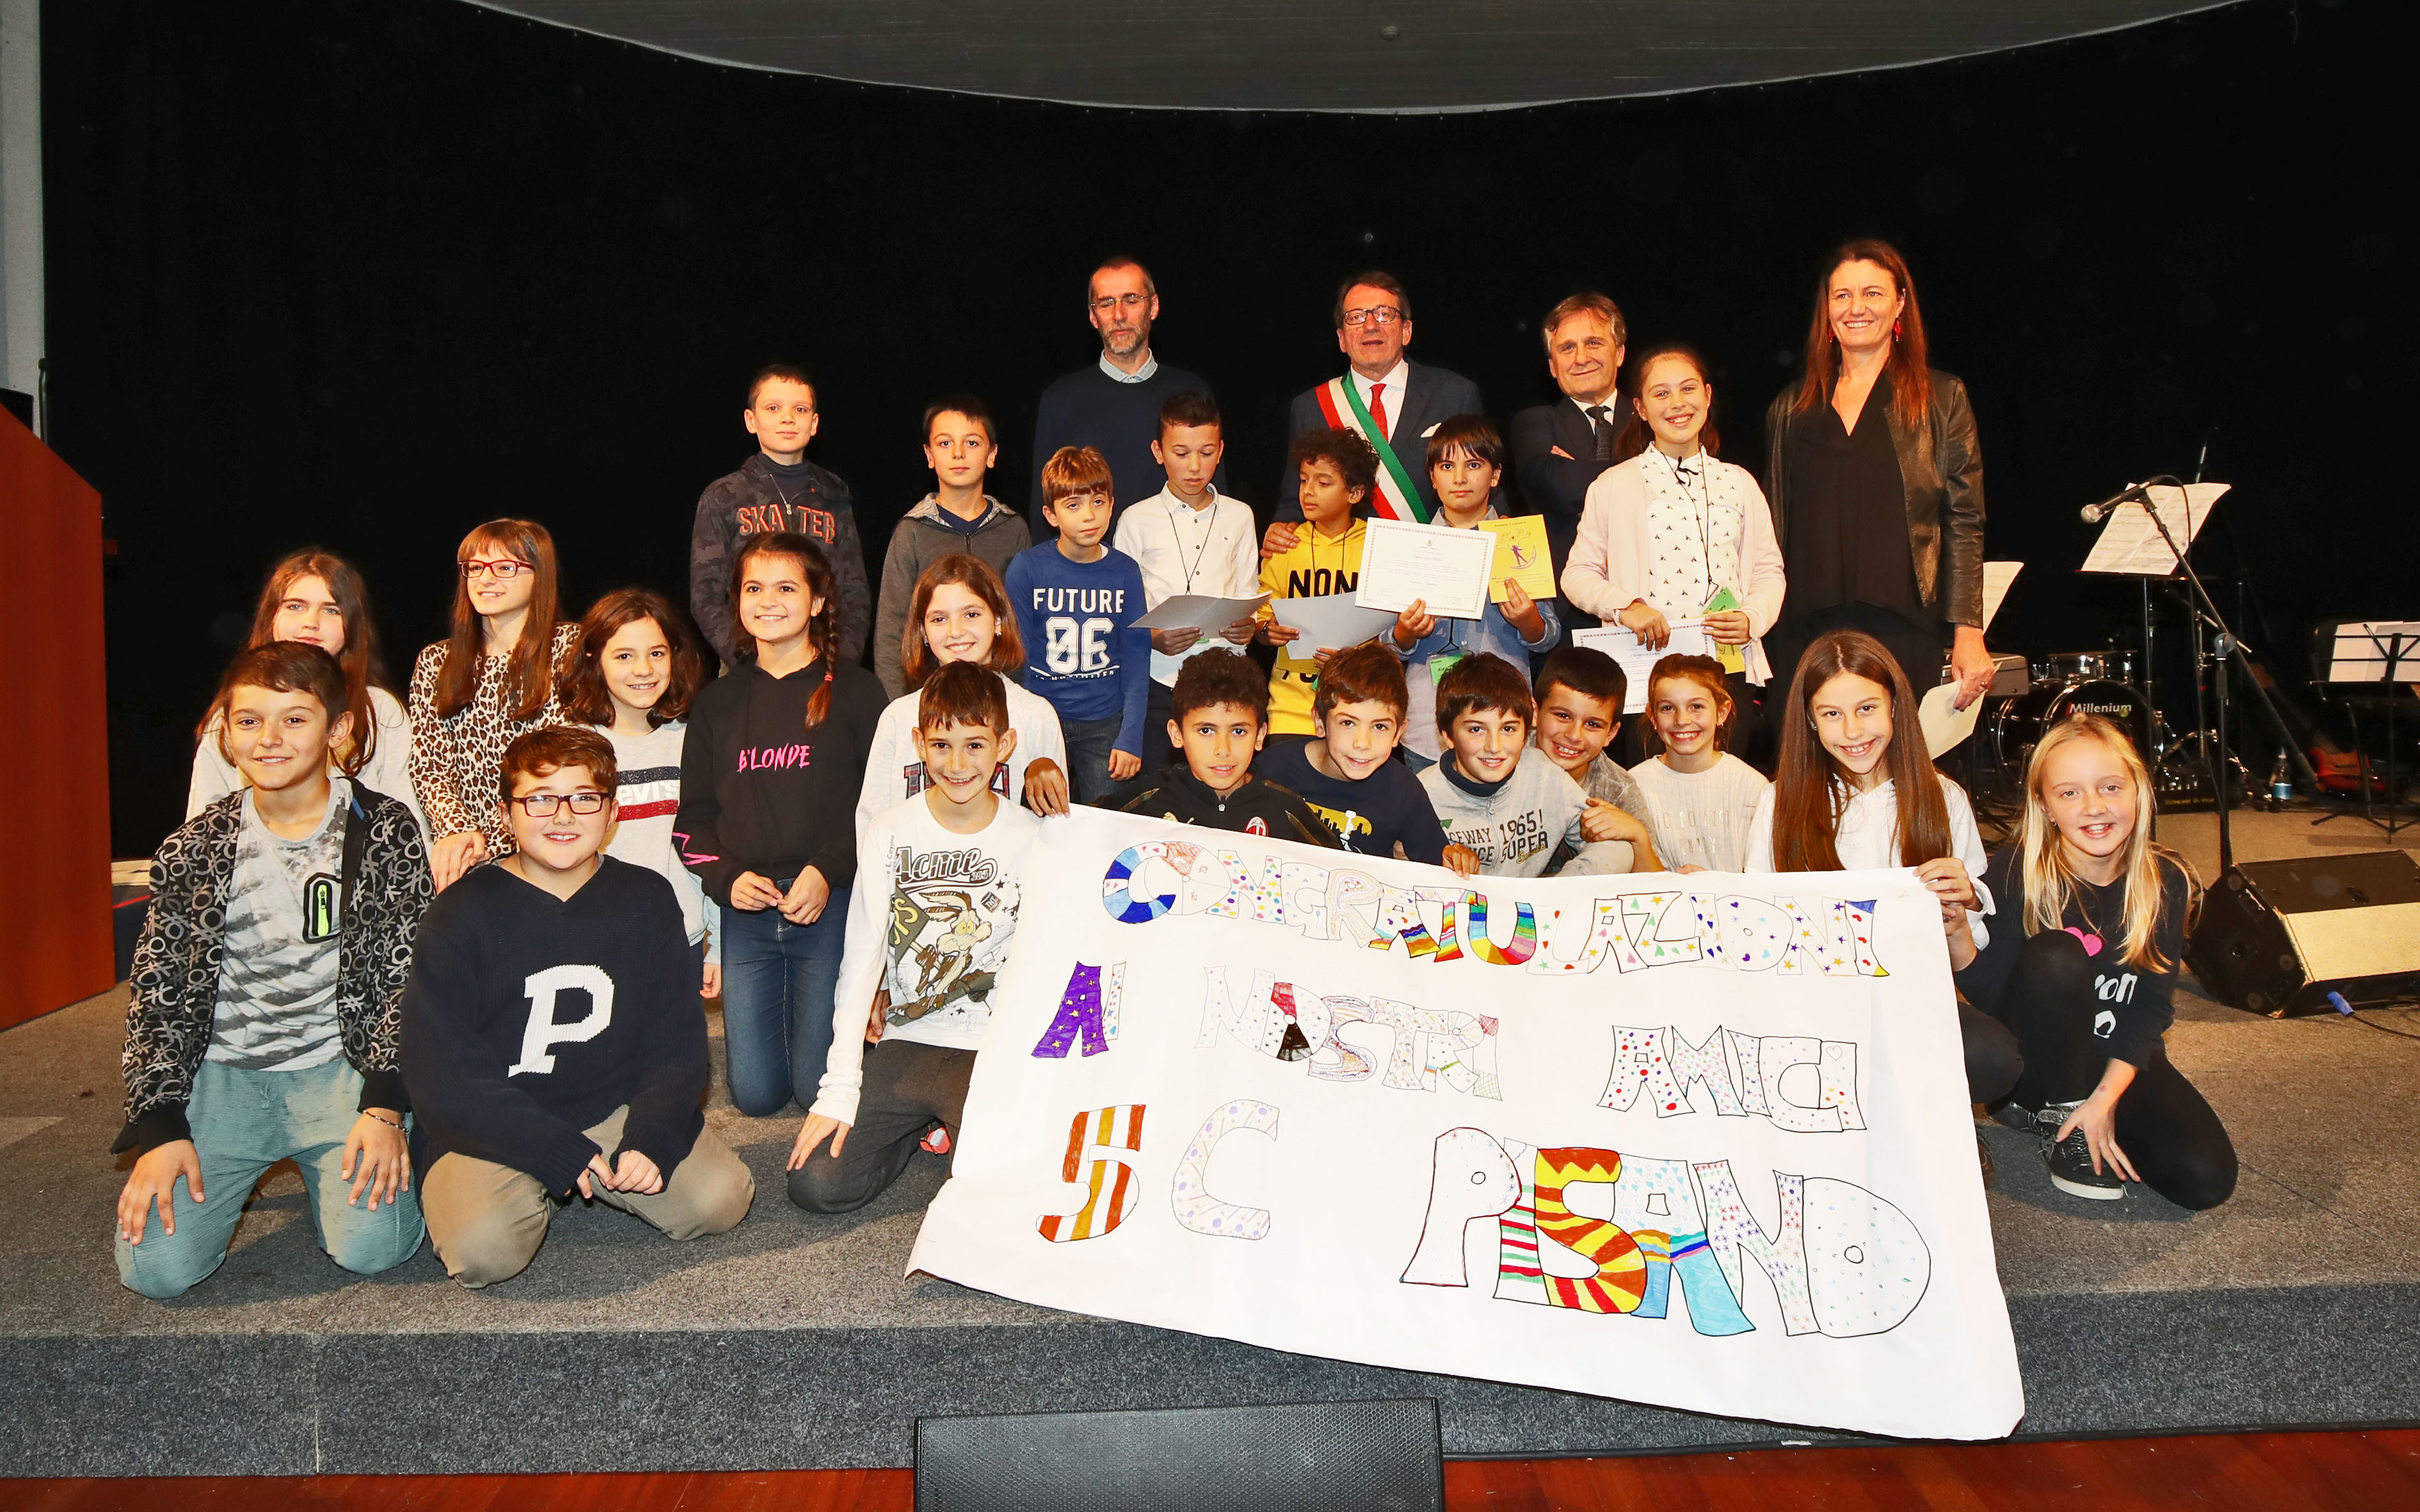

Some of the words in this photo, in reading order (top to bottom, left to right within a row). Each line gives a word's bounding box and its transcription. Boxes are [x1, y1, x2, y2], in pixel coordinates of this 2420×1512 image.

[1033, 588, 1125, 613] FUTURE
[2069, 702, 2132, 714] Millenium
[737, 743, 810, 773] BLONDE
[618, 780, 679, 805] evi's
[1449, 828, 1492, 845] CEWAY
[1500, 808, 1544, 846] 1965!
[895, 846, 982, 884] Acme
[1102, 841, 1889, 977] CONGRATULAZIONI
[508, 964, 615, 1078] P
[1031, 958, 1126, 1058] AI
[1195, 965, 1503, 1102] NOSTRI
[1596, 1025, 1867, 1132] AMICI
[1400, 1127, 1931, 1339] PISANO
